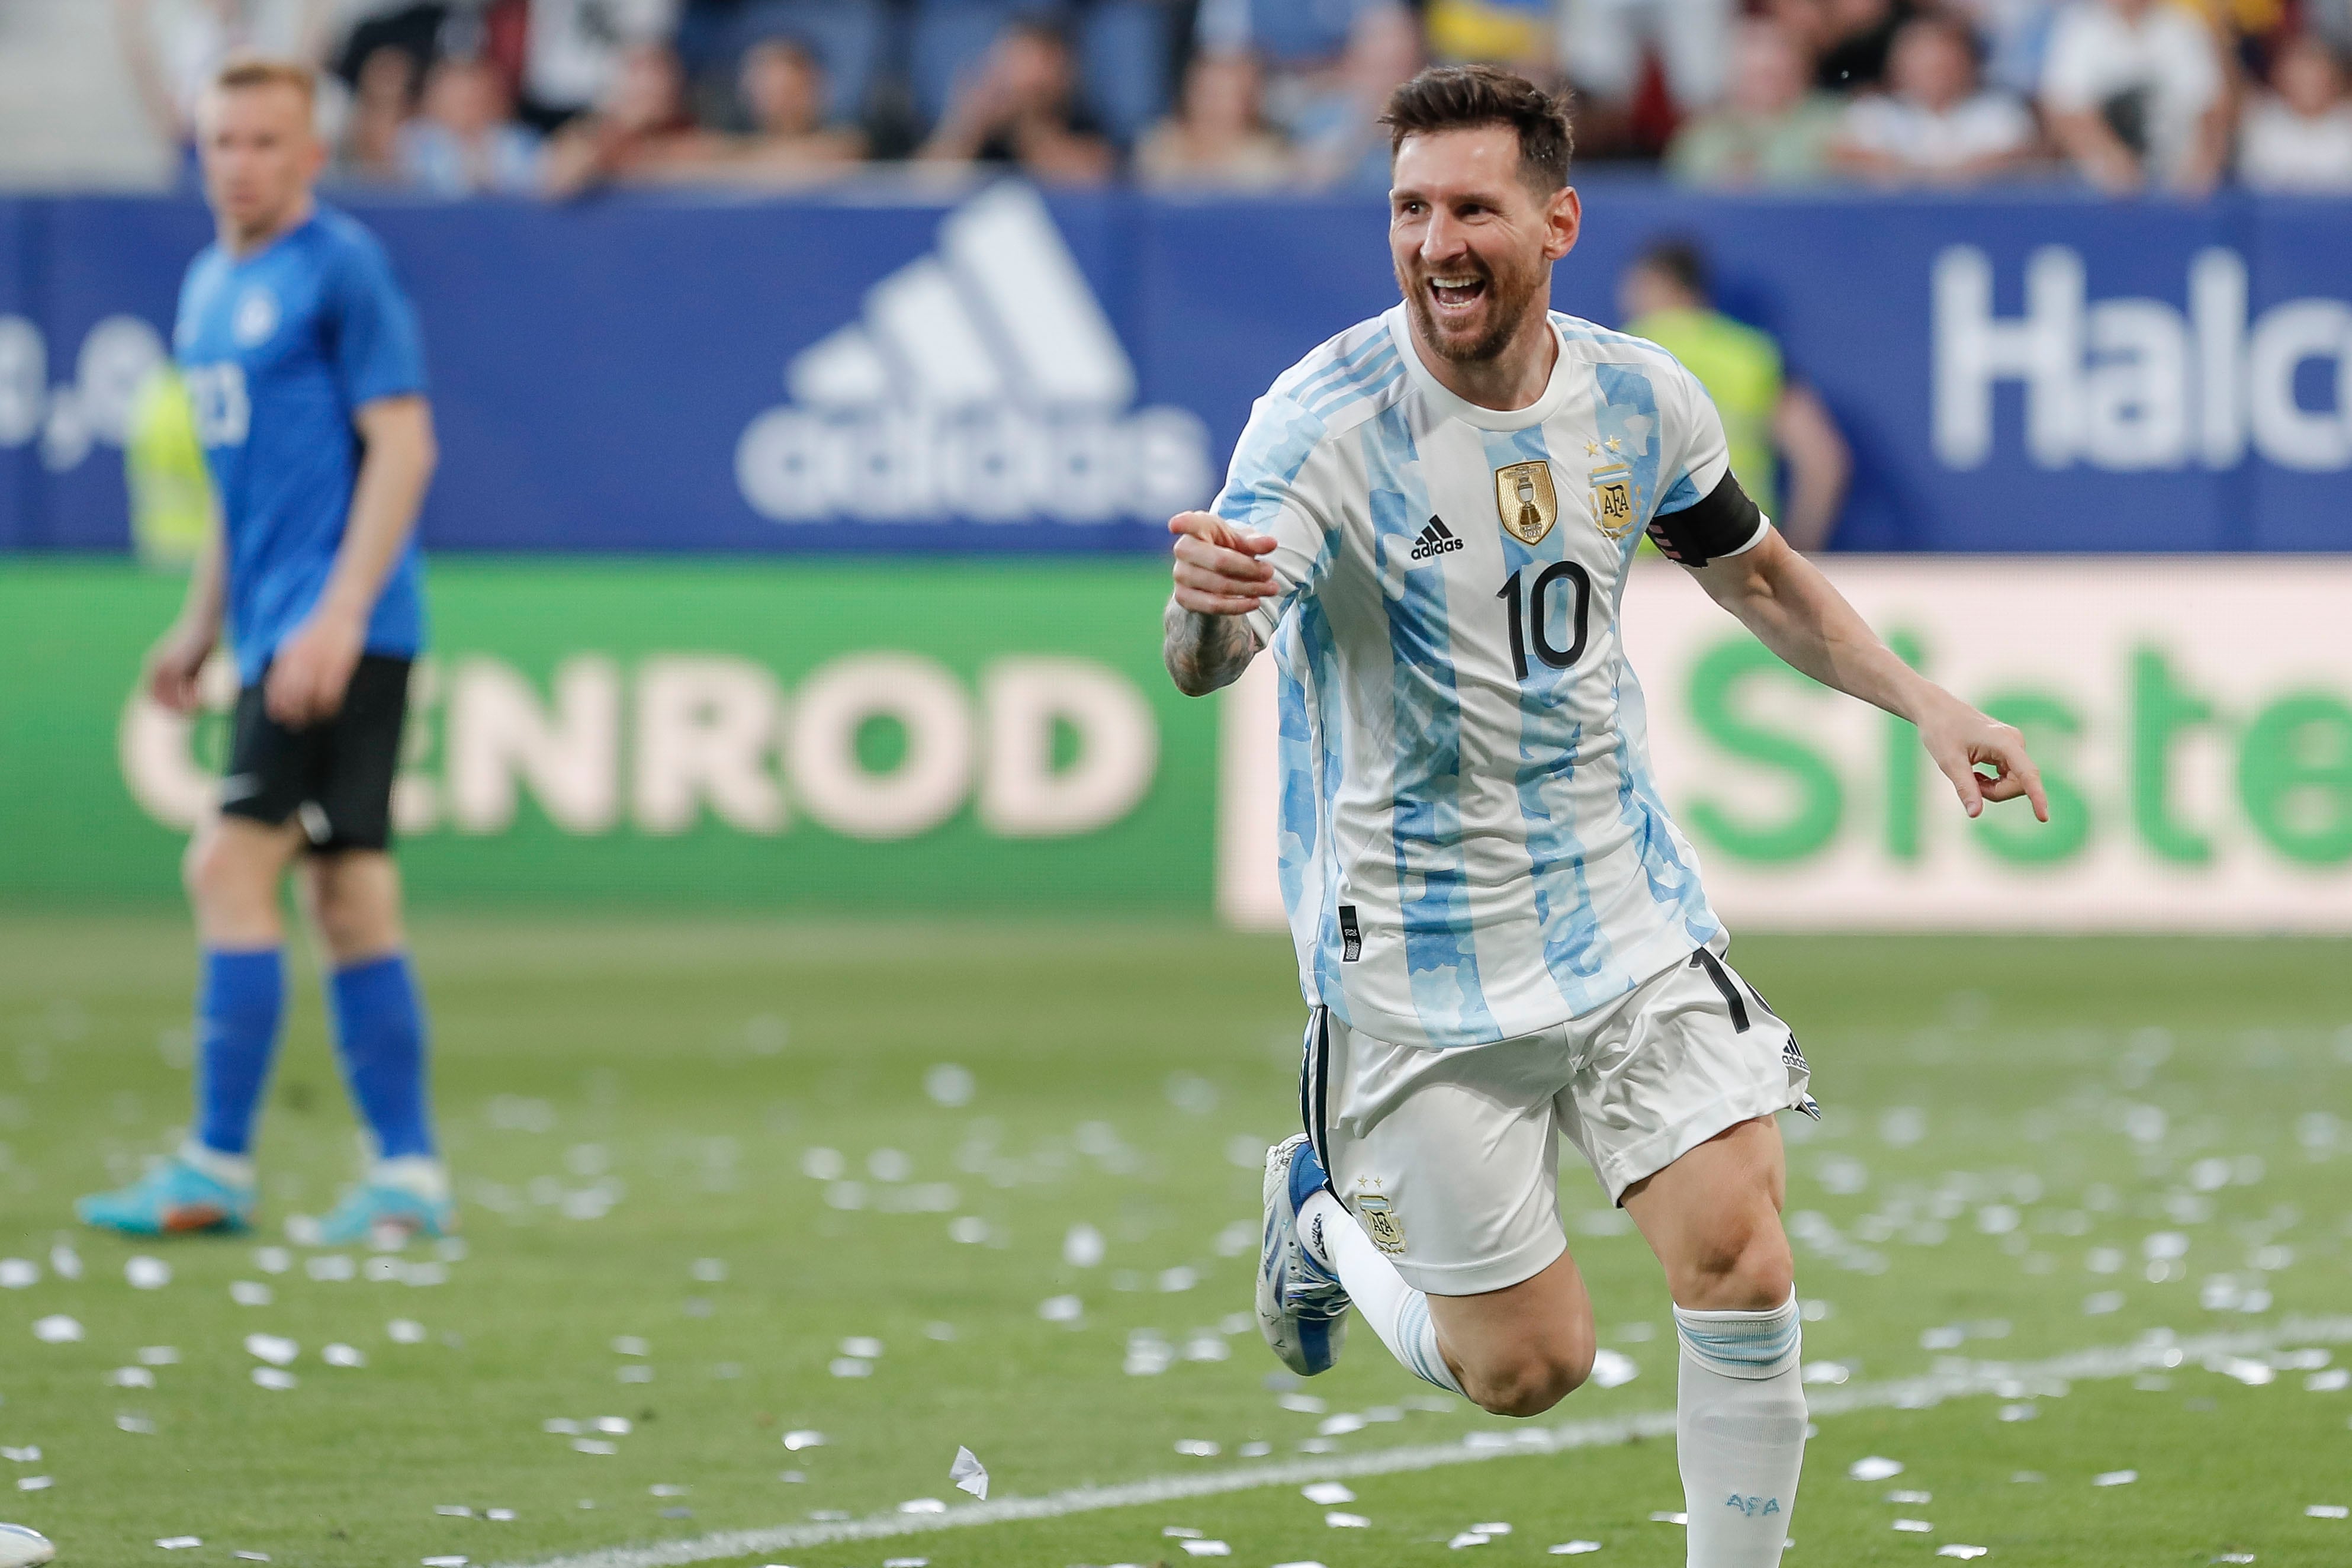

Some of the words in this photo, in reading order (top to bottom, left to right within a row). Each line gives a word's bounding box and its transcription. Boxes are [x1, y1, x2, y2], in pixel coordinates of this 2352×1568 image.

[1932, 245, 2352, 473] Halc
[1604, 484, 1630, 518] AFA
[1410, 538, 1464, 560] adidas
[1496, 560, 1591, 681] 10
[1370, 1210, 1395, 1236] AFA
[1726, 1494, 1780, 1516] AFA
